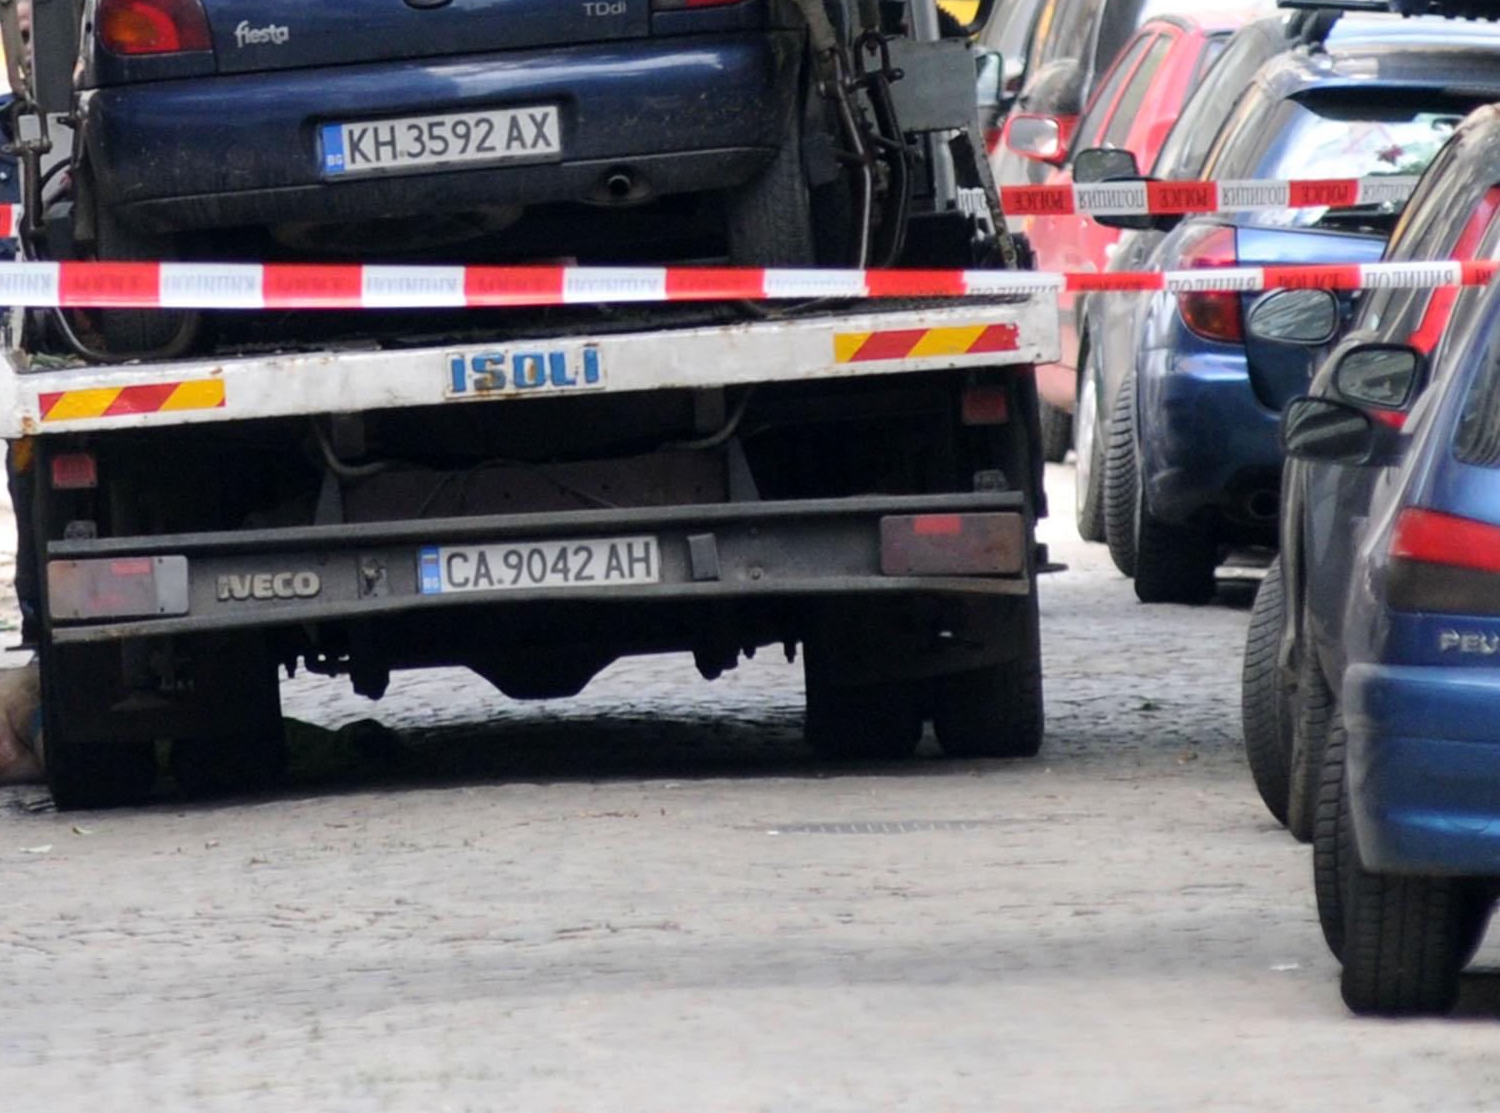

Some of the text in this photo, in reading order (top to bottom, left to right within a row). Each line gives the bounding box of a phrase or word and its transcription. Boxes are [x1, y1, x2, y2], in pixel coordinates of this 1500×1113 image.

[234, 20, 290, 48] fiesta
[451, 348, 600, 393] ISOLI
[217, 571, 321, 600] IVECO
